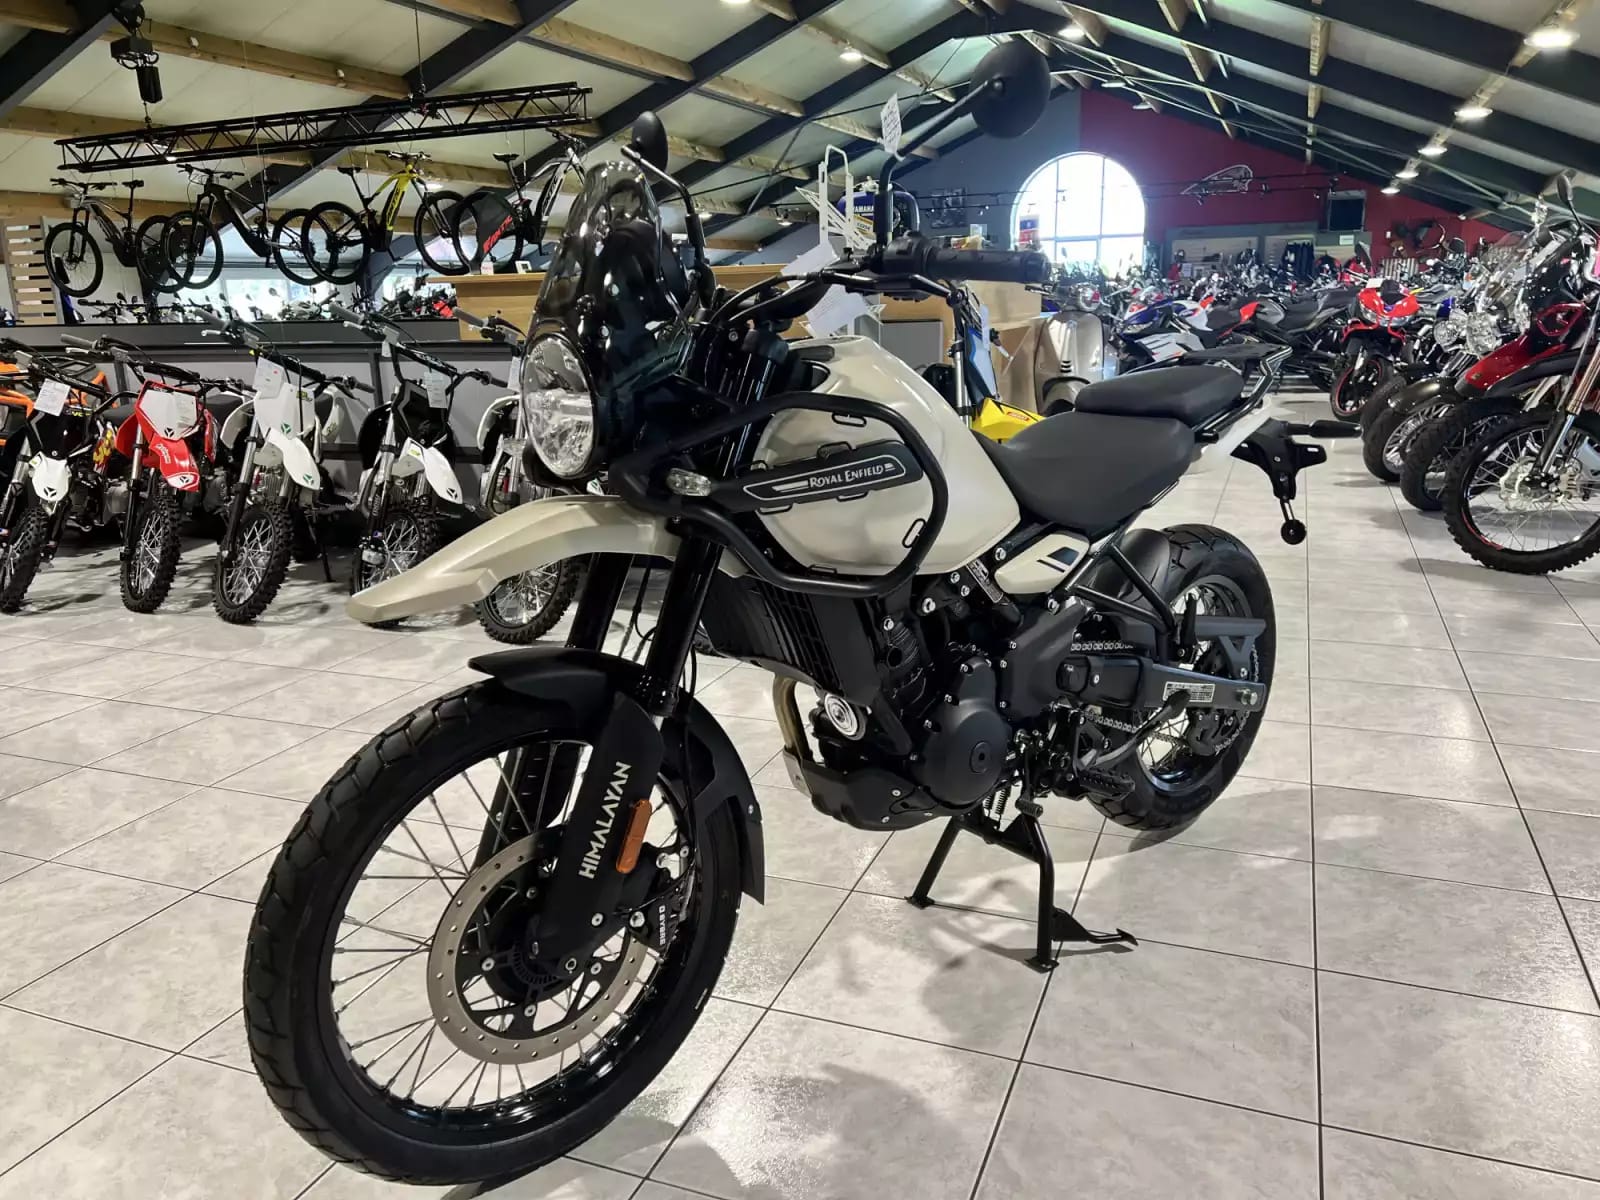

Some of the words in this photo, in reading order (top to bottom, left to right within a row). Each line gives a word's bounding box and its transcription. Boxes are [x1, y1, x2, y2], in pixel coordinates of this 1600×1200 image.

[809, 473, 843, 488] ROYAL
[844, 465, 884, 482] ENFIELD
[578, 761, 632, 879] HIMALAYAN
